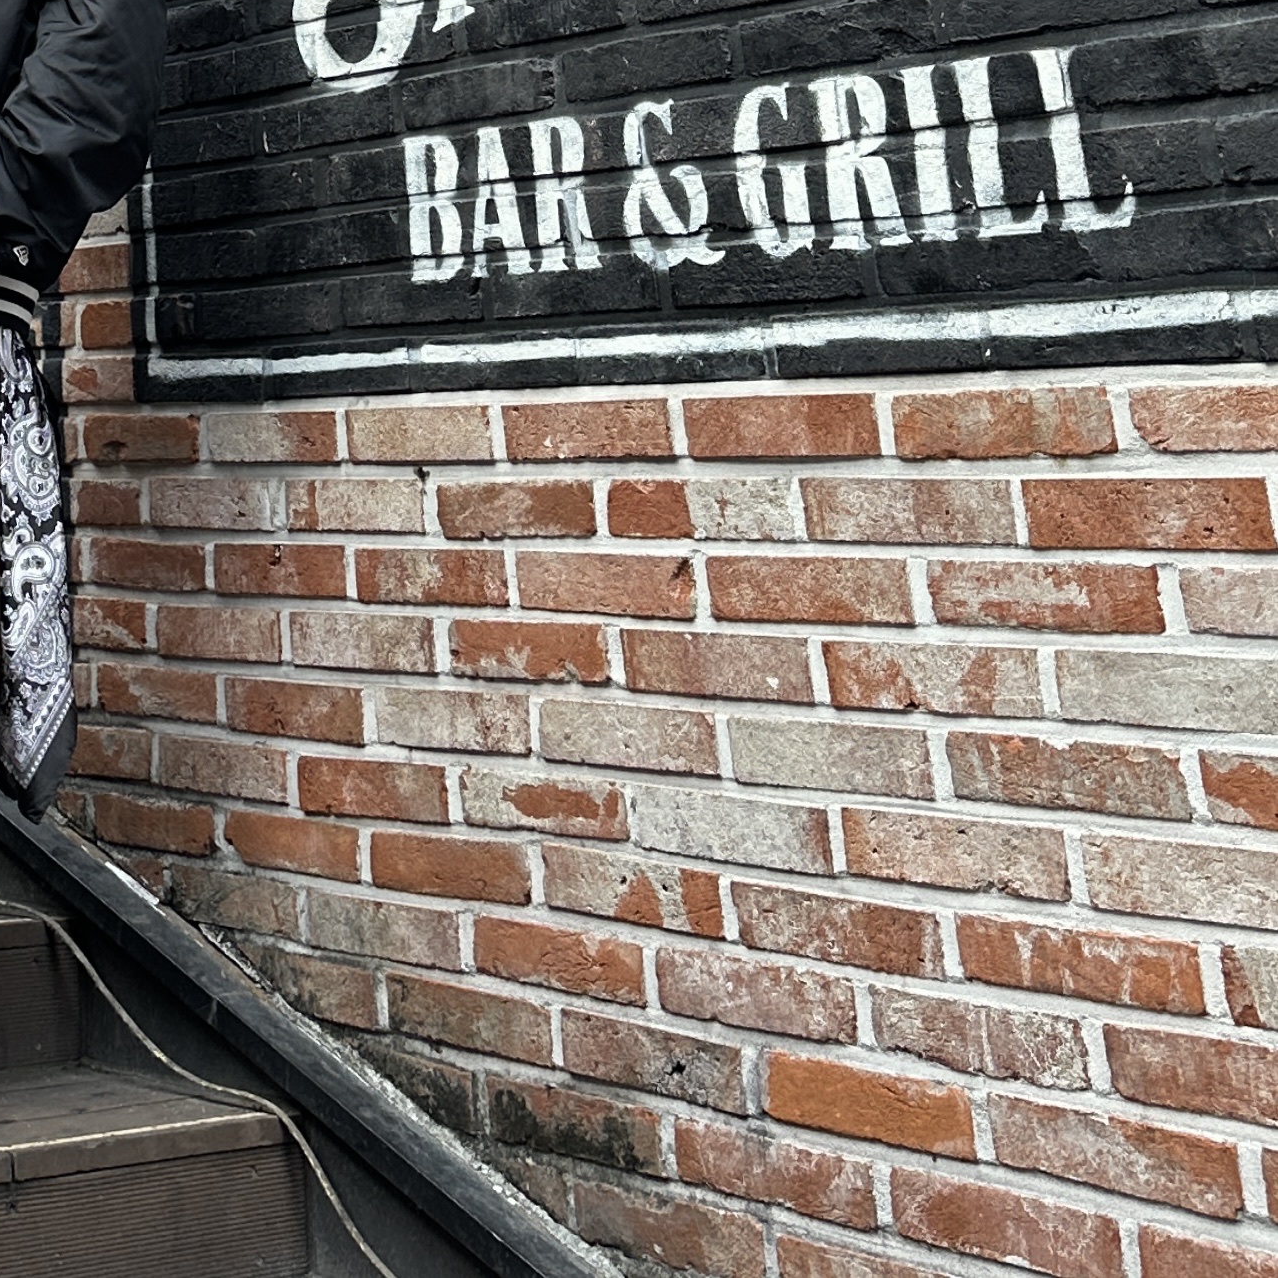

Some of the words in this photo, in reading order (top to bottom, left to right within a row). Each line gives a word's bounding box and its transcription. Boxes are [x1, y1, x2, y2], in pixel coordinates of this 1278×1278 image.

[403, 115, 604, 283] BAR
[623, 98, 726, 269] &
[732, 45, 1137, 260] GRILL
